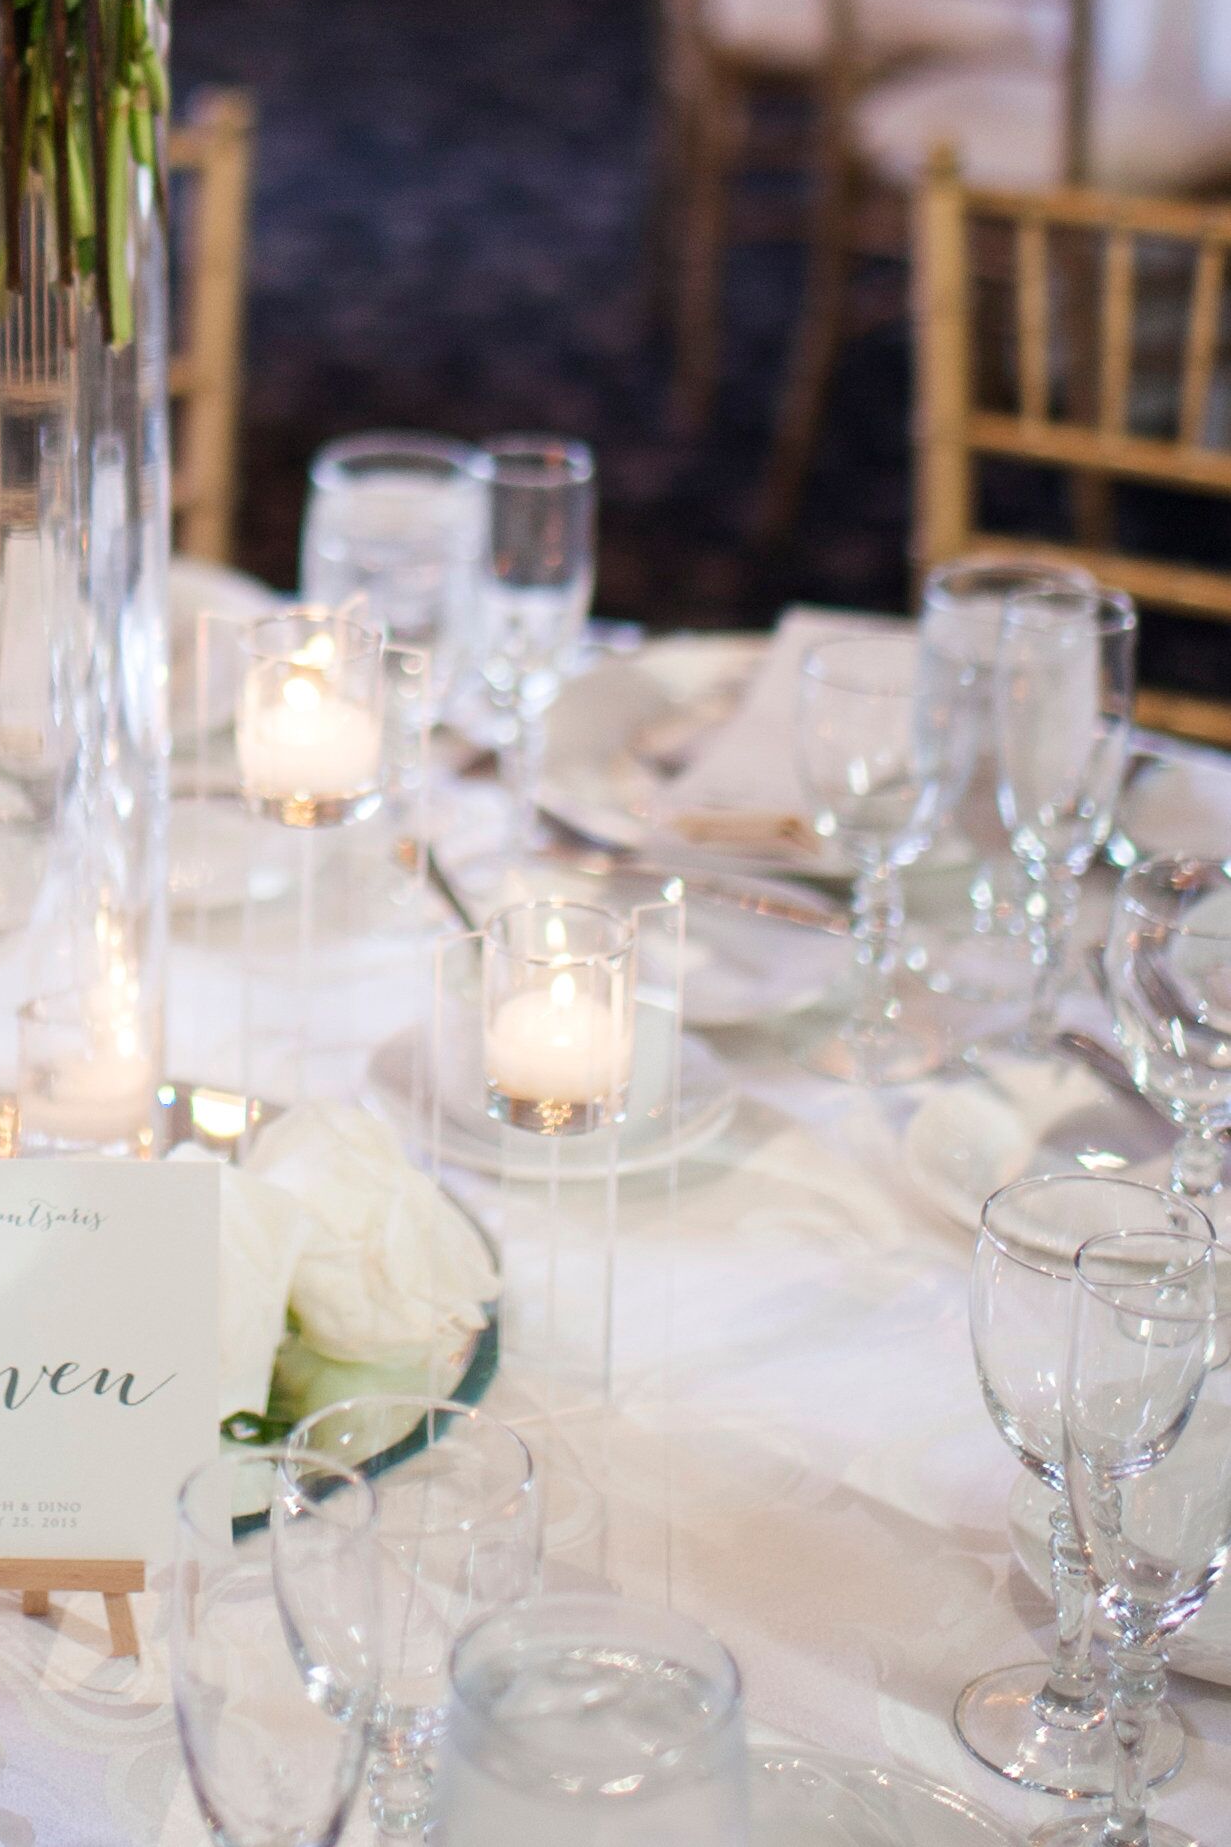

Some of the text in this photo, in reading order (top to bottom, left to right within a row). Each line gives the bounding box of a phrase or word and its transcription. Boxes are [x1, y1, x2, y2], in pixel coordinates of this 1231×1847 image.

[20, 1501, 30, 1513] &
[37, 1501, 82, 1513] DINO
[41, 1516, 78, 1529] 2015
